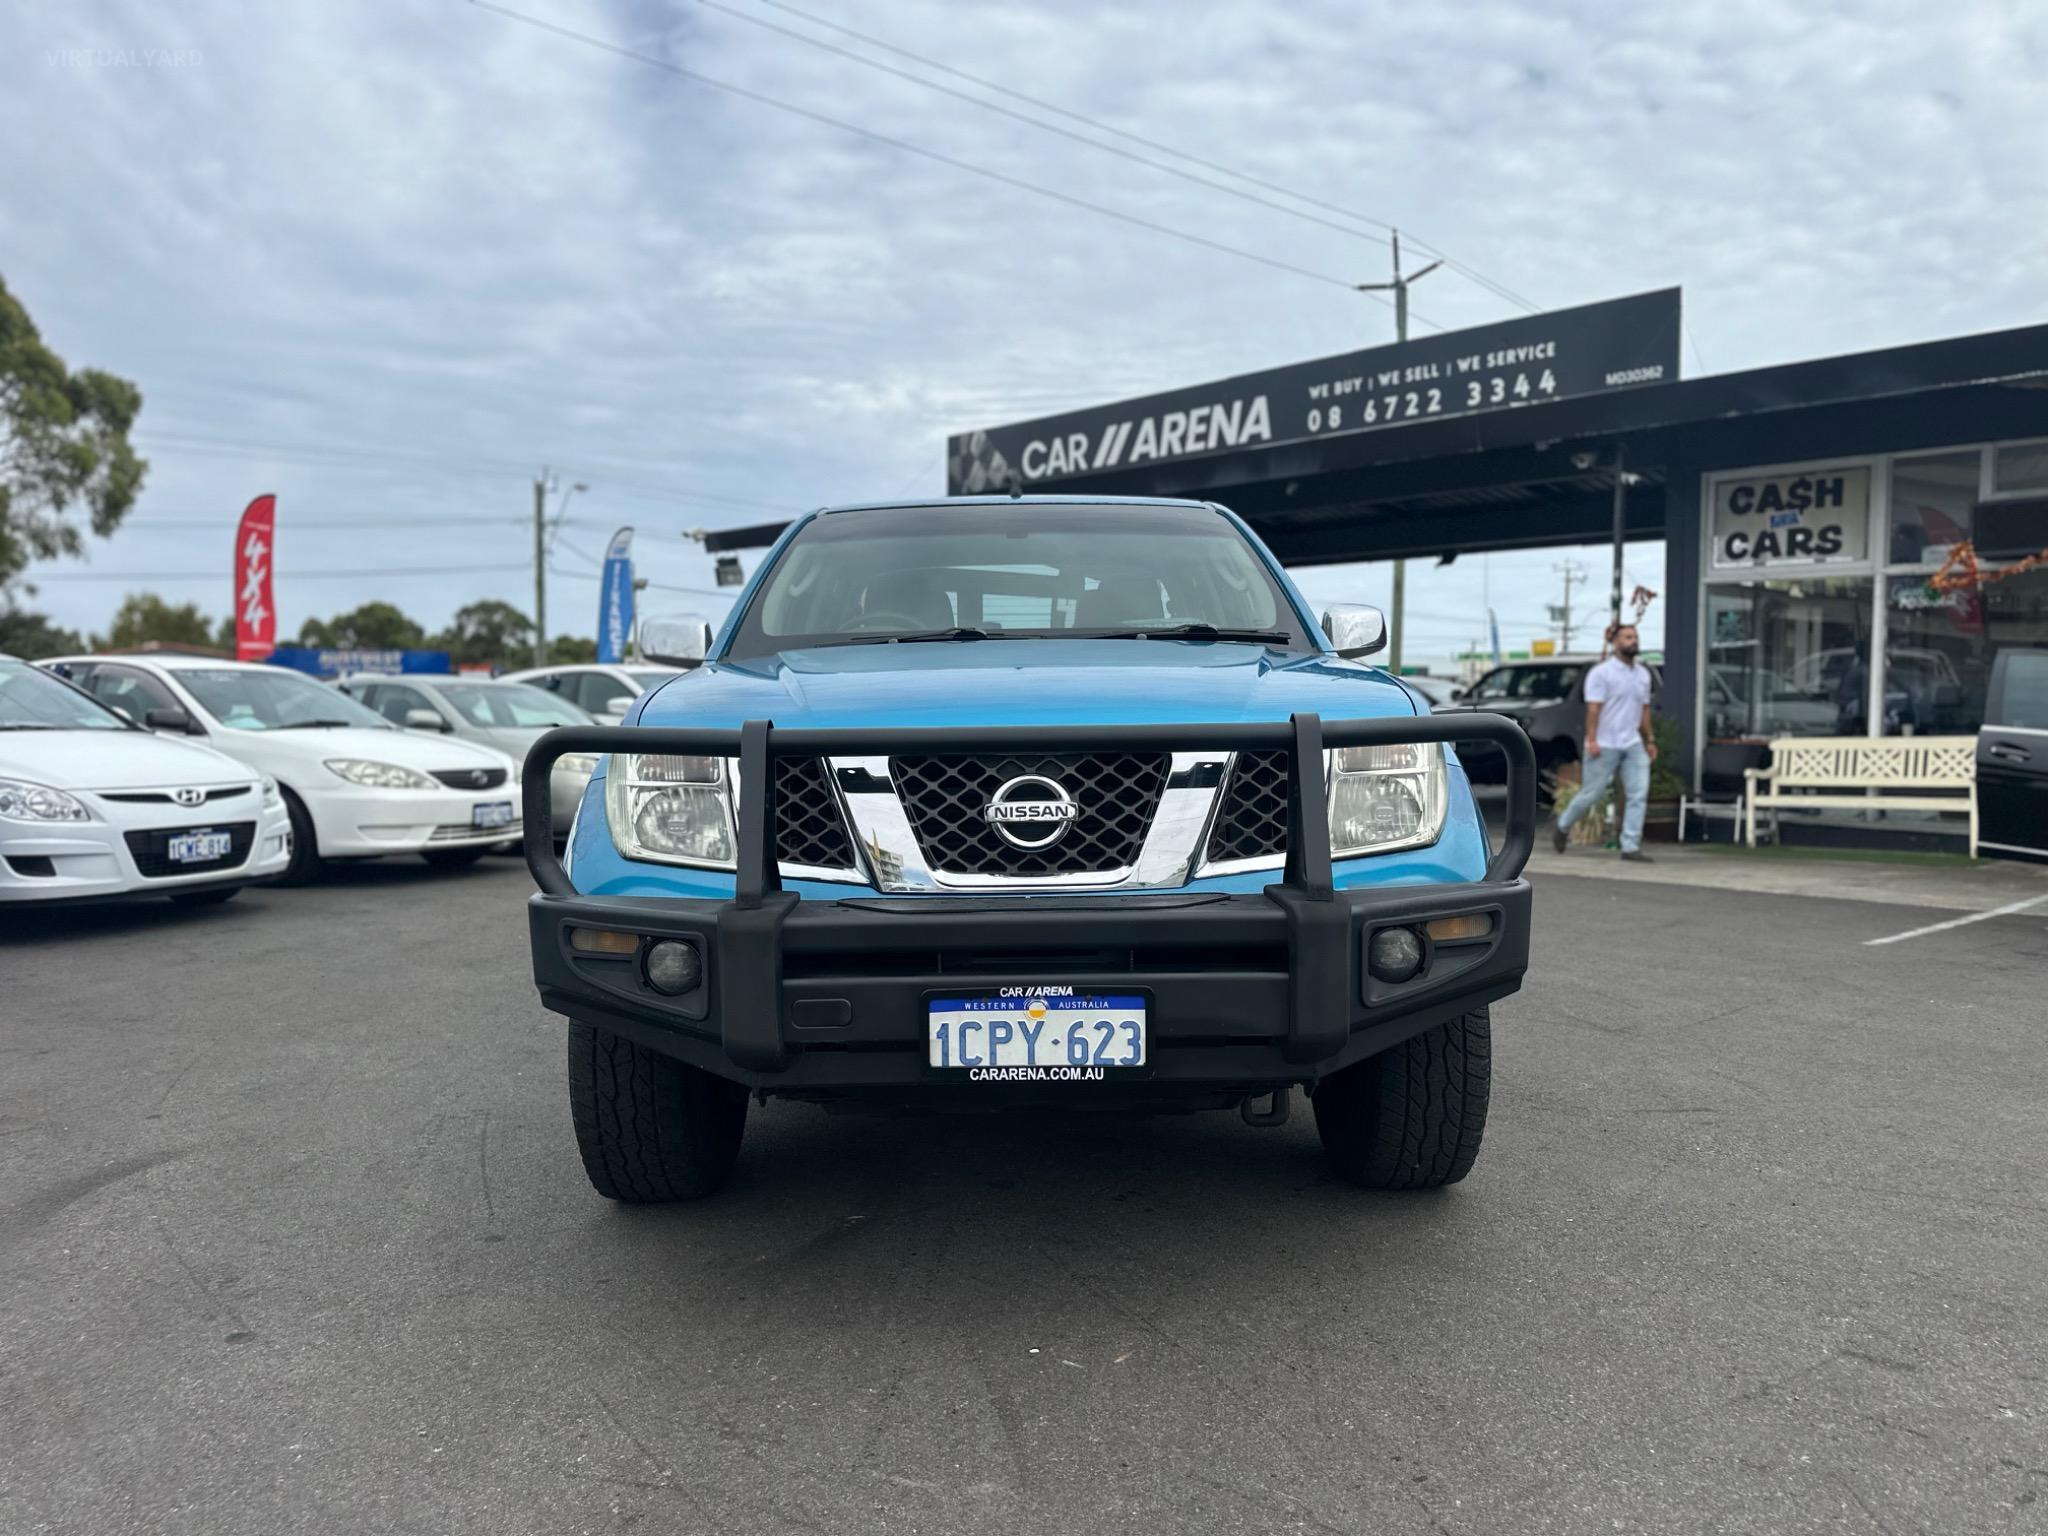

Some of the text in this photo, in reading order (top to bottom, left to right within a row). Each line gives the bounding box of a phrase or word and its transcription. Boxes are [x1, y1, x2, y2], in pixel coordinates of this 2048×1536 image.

[1309, 383, 1329, 399] WE
[1333, 377, 1363, 396] BUY
[1378, 370, 1400, 388] WE
[1405, 363, 1439, 383] SELL
[1456, 355, 1480, 373] WE
[1487, 342, 1556, 369] SERVICE
[1307, 369, 1556, 432] 08 6722 3344
[1021, 432, 1089, 479] CAR
[1725, 524, 1843, 560] CARS
[994, 805, 1069, 819] NISSAN
[1000, 987, 1023, 997] CAR
[964, 1001, 1109, 1010] WESTERN AUSTRALIA
[969, 1067, 1104, 1081] CARARENA.COM.AU
